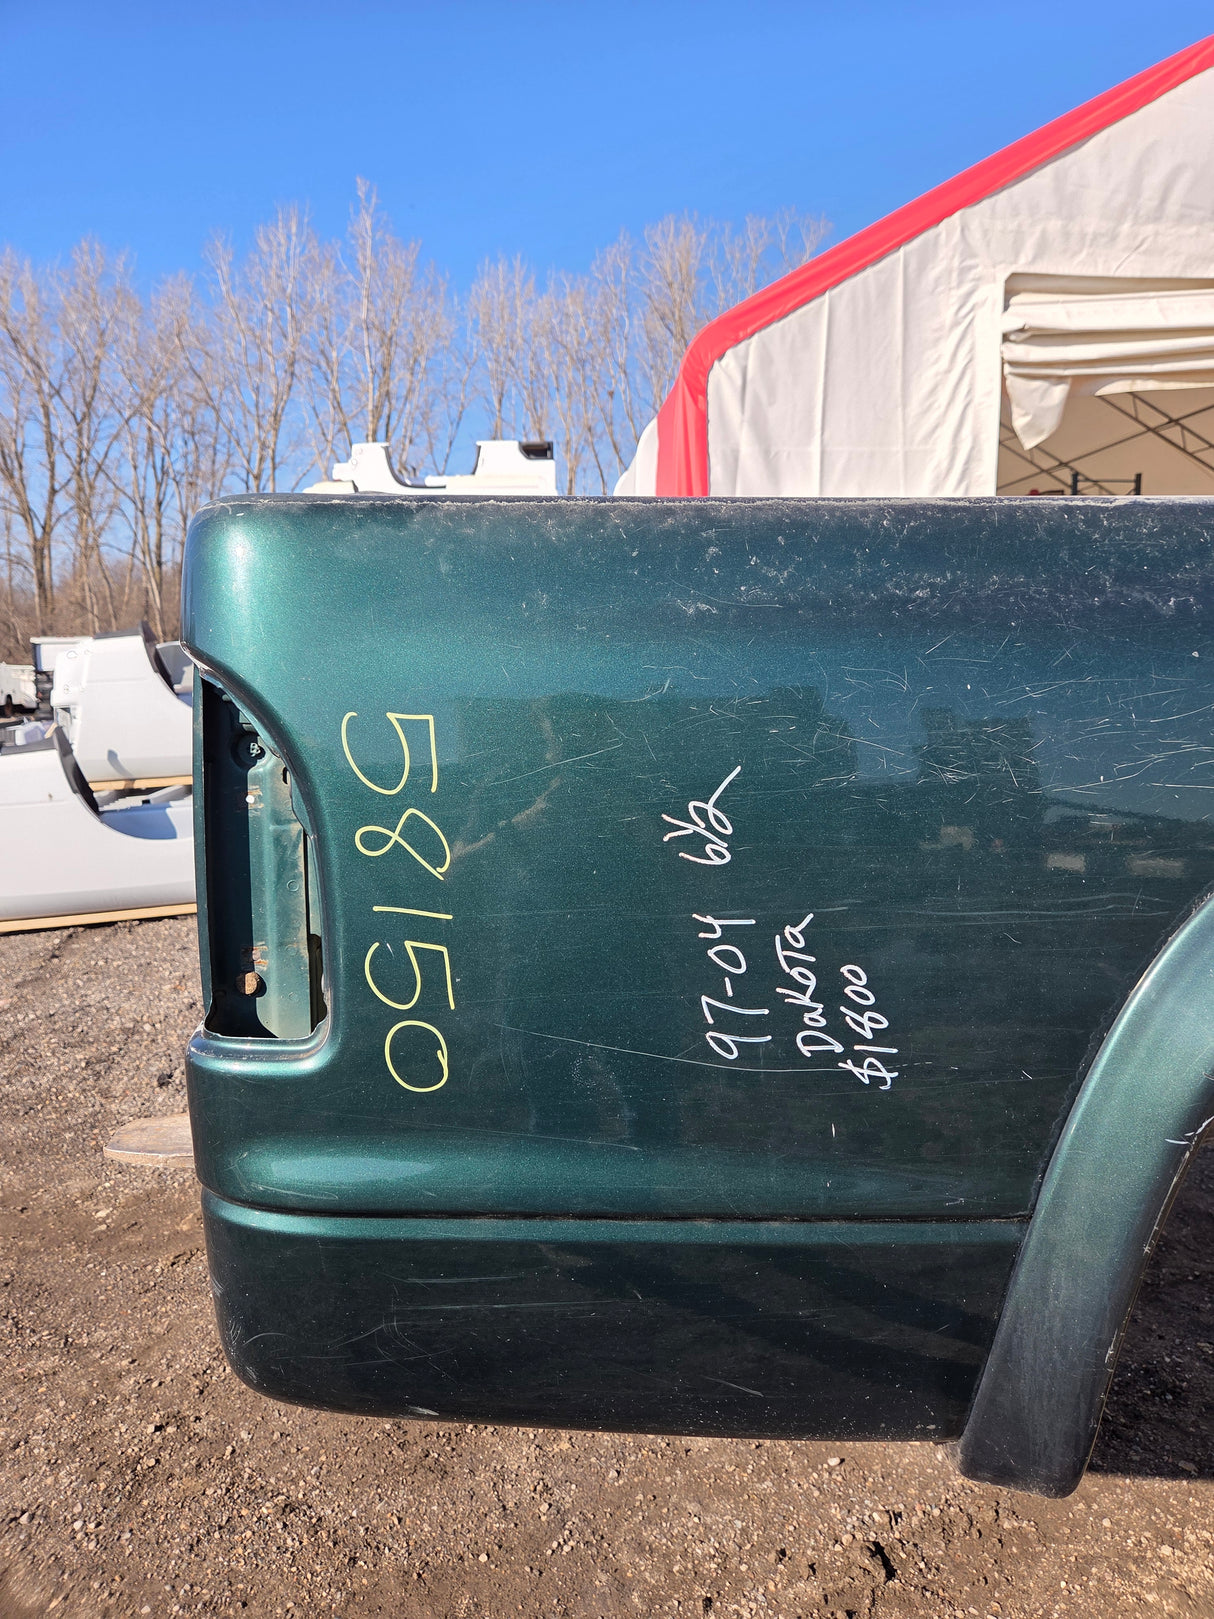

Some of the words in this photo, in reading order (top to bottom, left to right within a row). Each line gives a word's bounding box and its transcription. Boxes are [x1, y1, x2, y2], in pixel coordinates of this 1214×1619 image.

[341, 711, 456, 1093] 58150
[691, 913, 773, 1060] 97-04
[838, 964, 899, 1090] $1800
